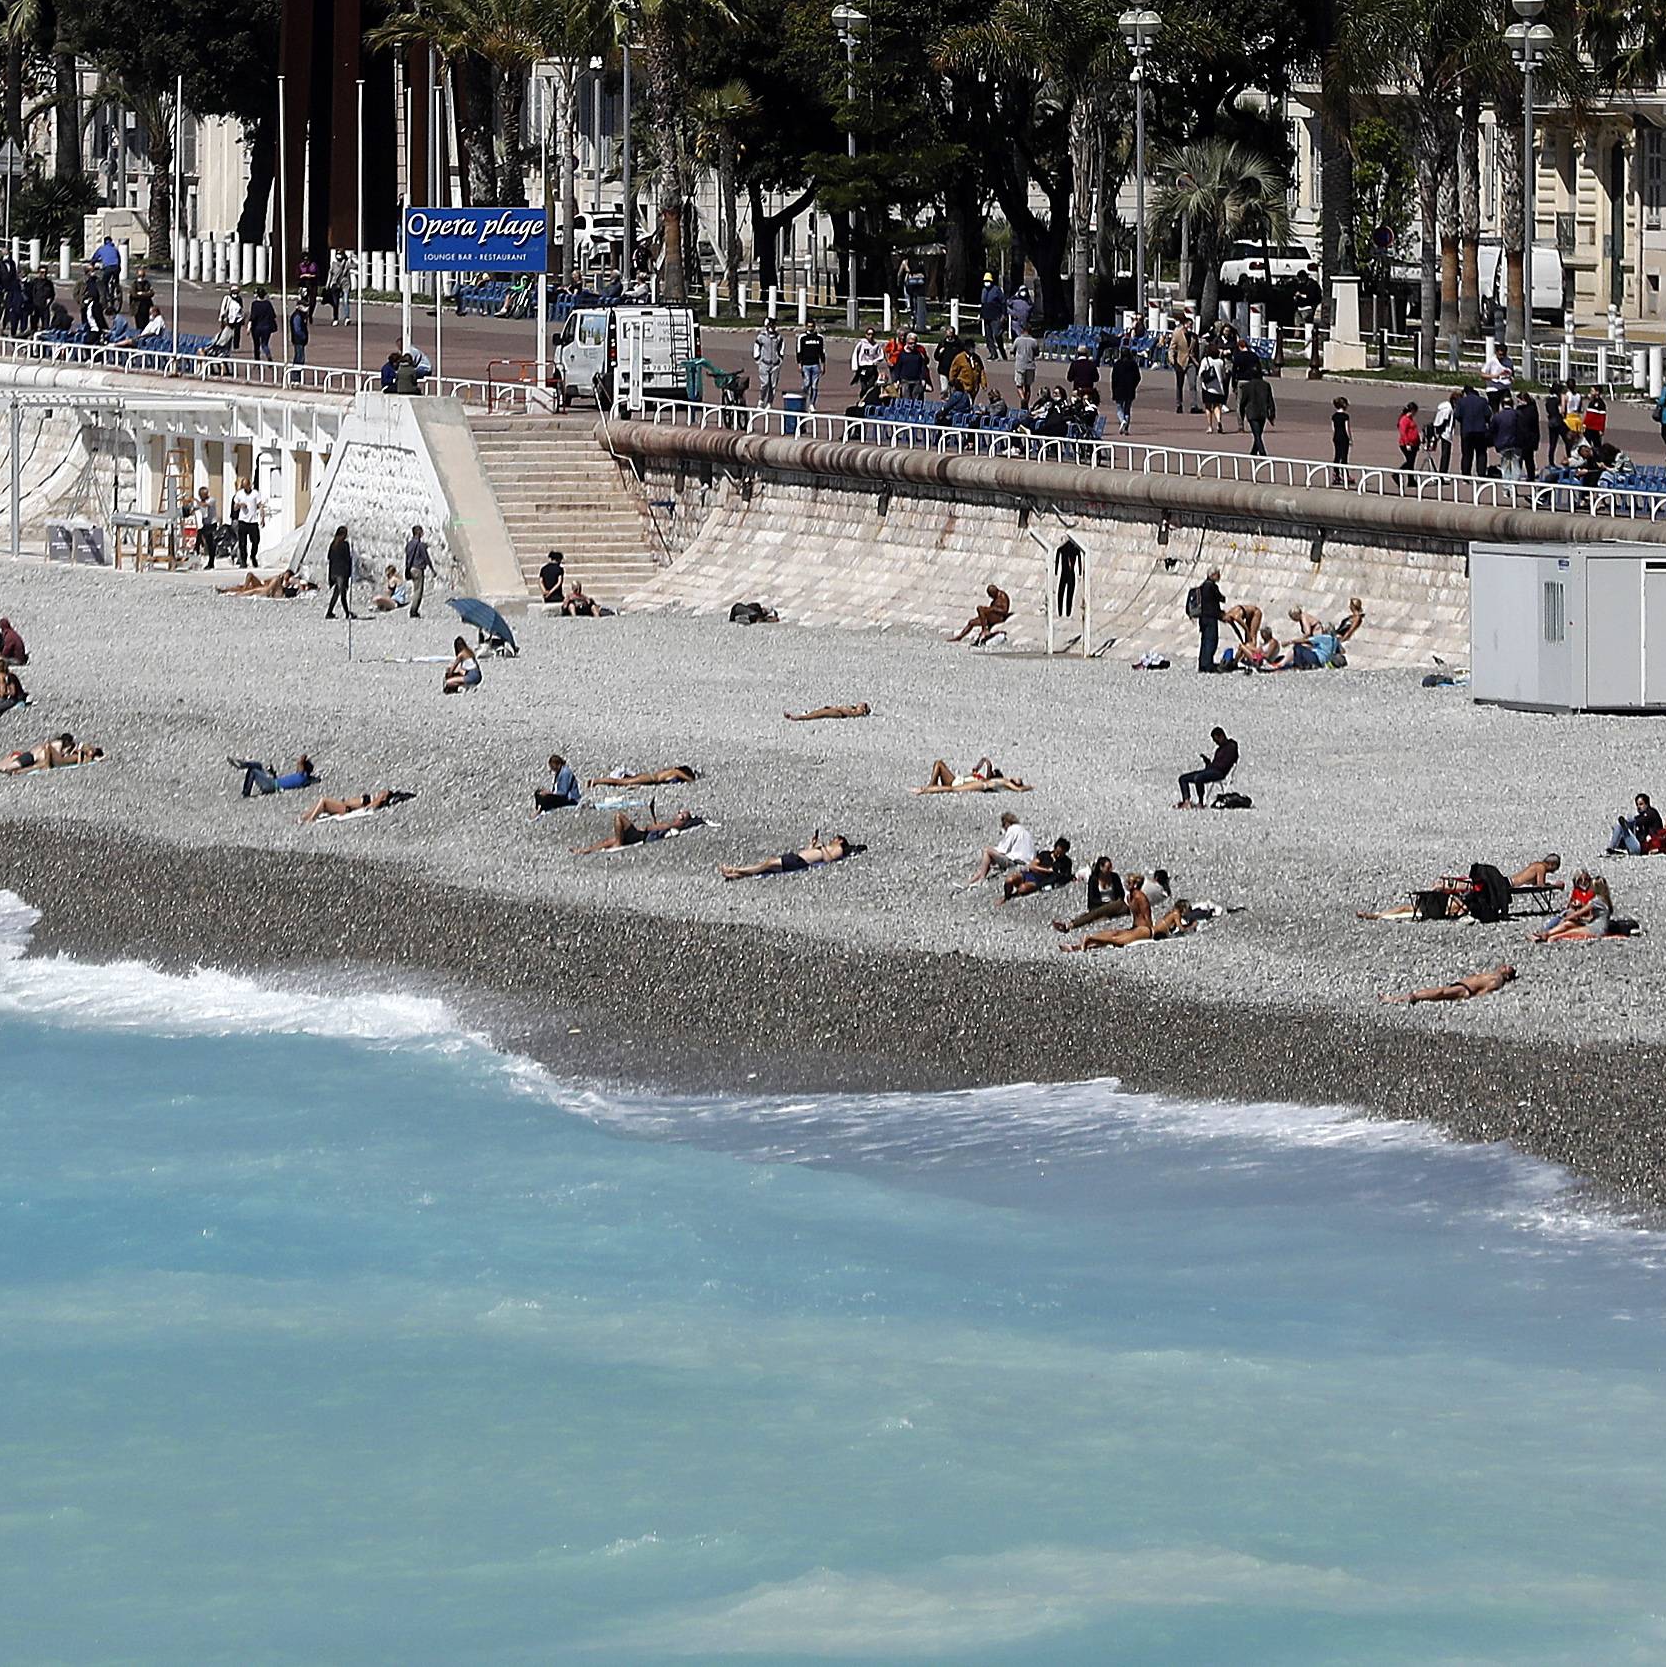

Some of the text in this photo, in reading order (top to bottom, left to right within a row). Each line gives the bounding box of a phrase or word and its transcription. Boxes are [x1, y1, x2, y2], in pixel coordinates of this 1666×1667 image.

[407, 210, 545, 245] Opera plage
[423, 253, 455, 261] LOUNGE
[457, 253, 472, 261] BAR
[479, 253, 527, 261] RESTAURANT
